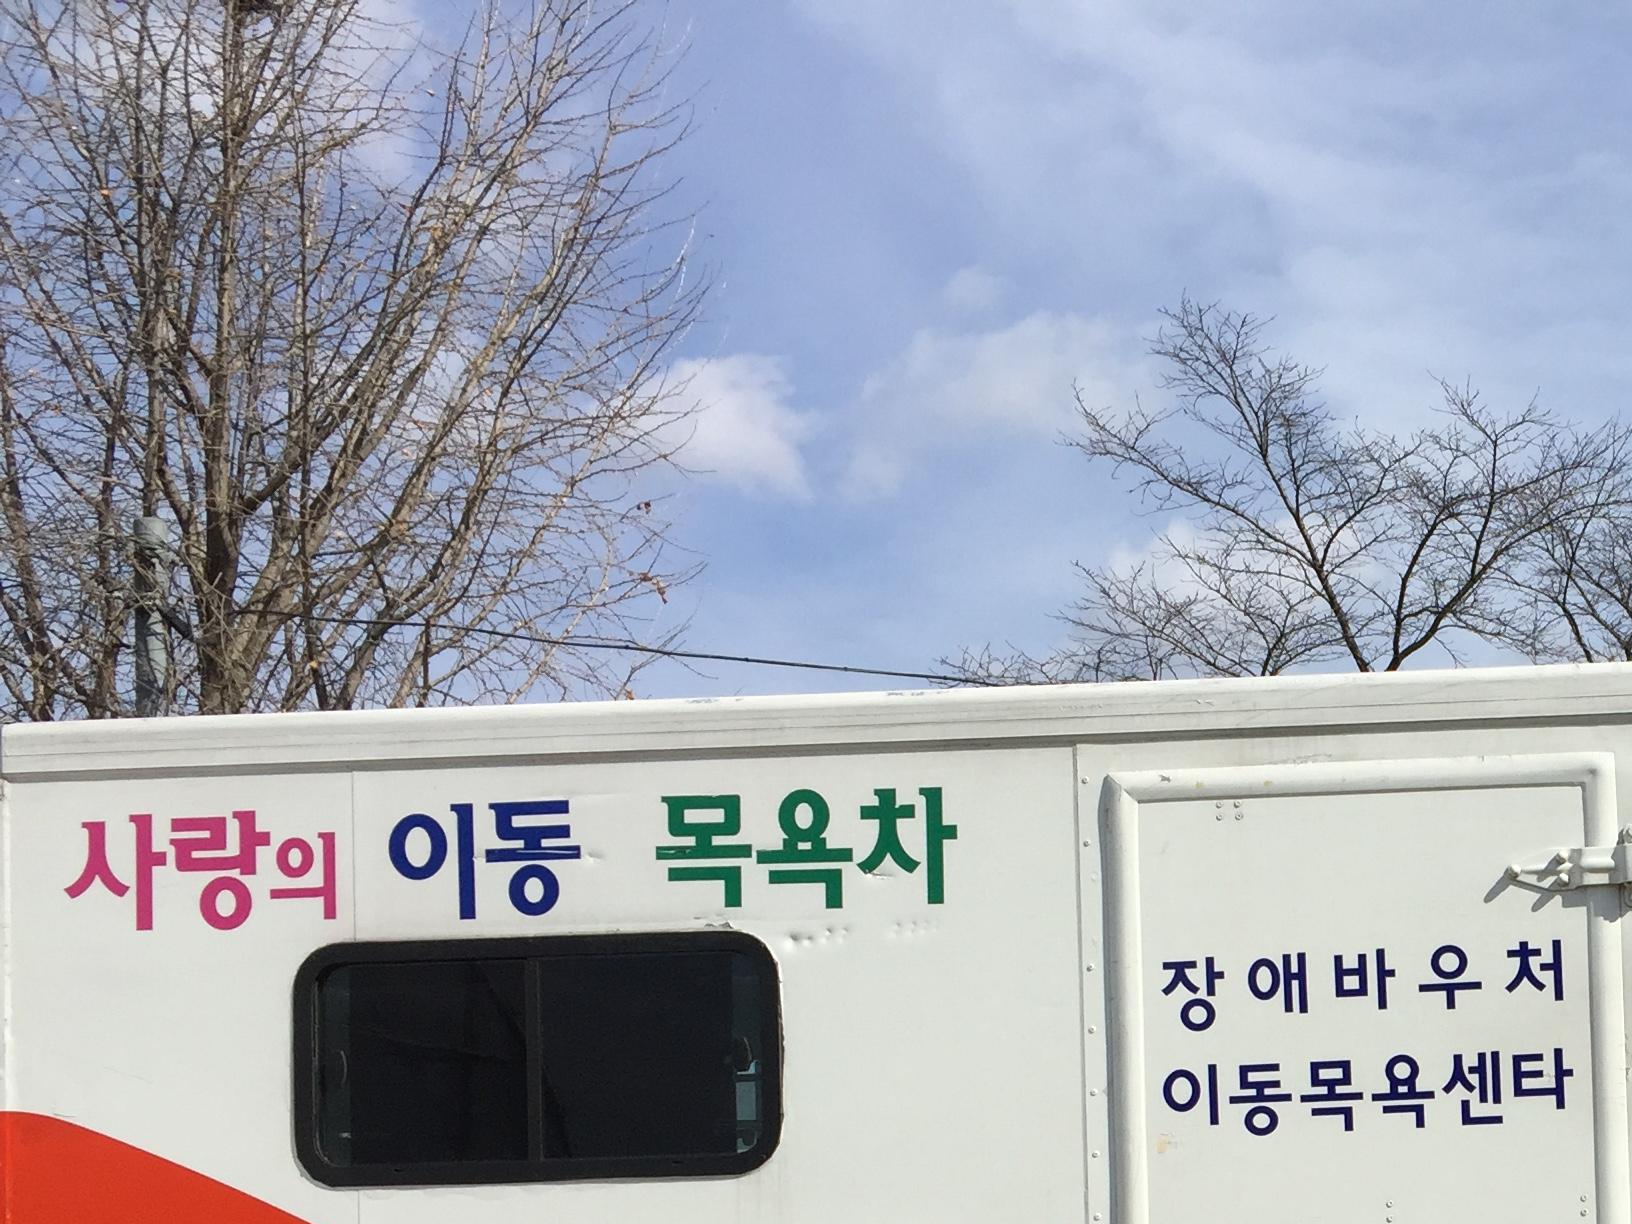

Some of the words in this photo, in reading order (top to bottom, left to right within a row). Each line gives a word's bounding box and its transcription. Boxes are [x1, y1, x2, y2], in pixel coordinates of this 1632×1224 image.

[64, 810, 337, 931] 사랑의
[388, 799, 582, 920] 이동
[655, 786, 958, 910] 목욕차
[1162, 1047, 1575, 1137] 이동목욕센타
